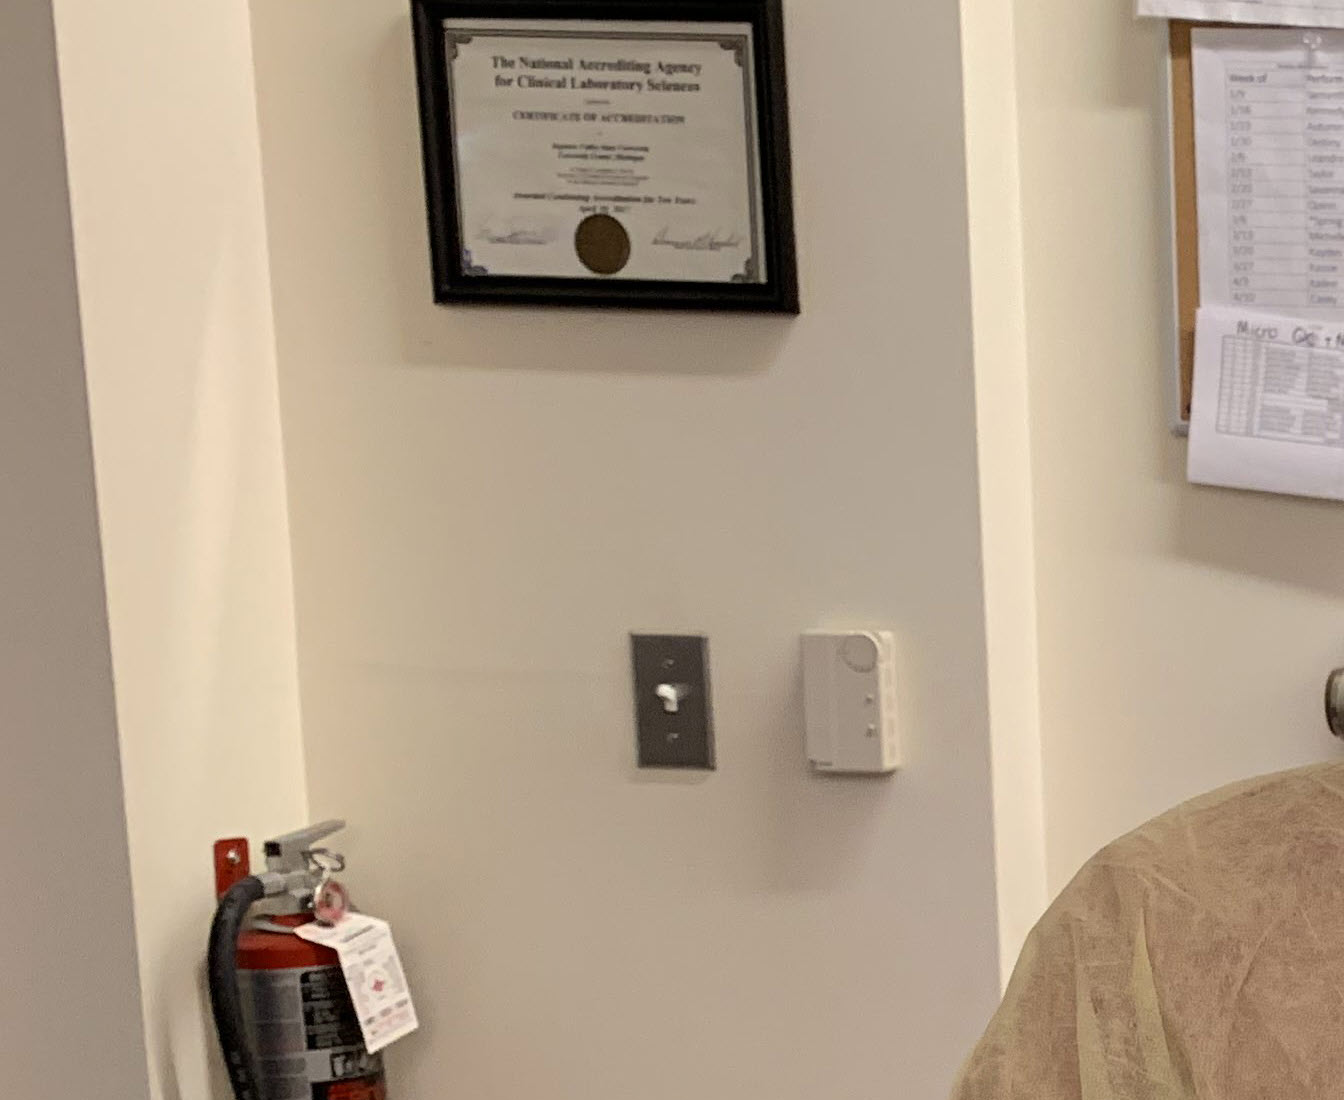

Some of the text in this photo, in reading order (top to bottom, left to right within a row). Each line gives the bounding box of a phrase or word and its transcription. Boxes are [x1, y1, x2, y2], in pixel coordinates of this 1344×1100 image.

[492, 56, 702, 75] The National Accrediting Agency
[494, 75, 701, 93] for Clinical Laboratory Sciences
[1229, 74, 1254, 82] Week
